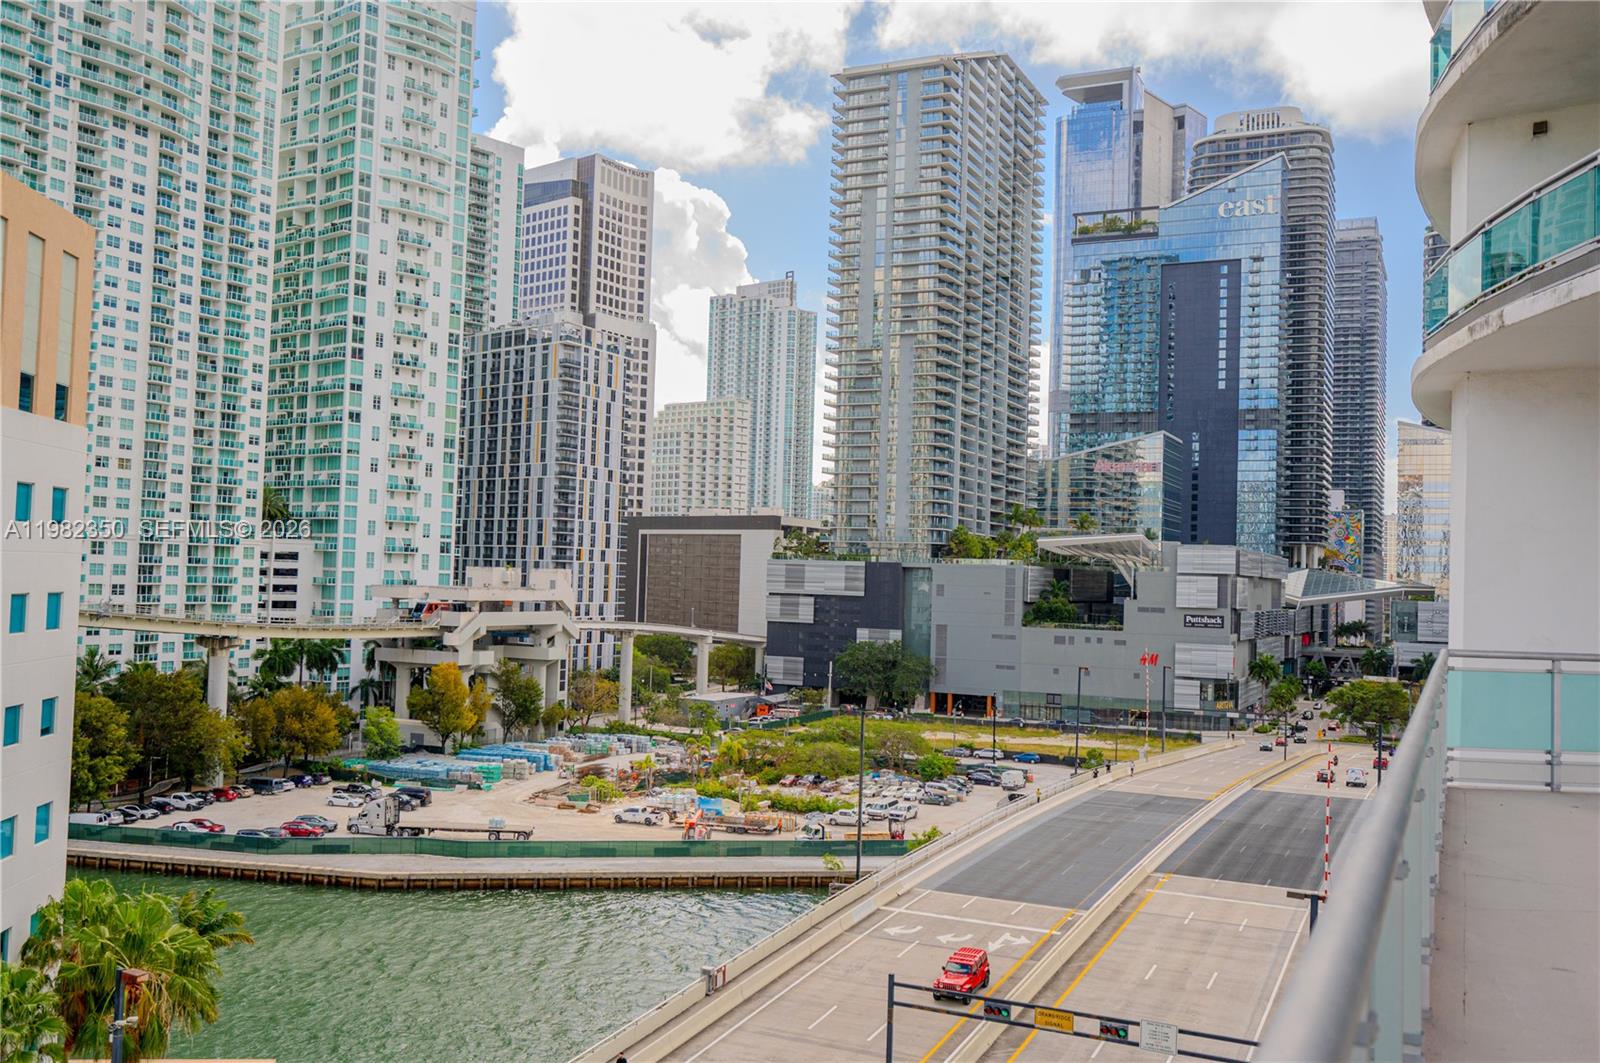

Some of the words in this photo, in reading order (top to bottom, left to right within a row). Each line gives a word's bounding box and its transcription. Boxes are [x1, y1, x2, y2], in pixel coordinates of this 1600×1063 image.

[602, 159, 627, 172] NORTHERN
[628, 169, 648, 178] TRUST
[1218, 194, 1278, 218] east
[1186, 615, 1222, 624] Puttshack
[1140, 653, 1158, 666] HM
[1038, 1010, 1071, 1022] DRAWBRIDGE
[1044, 1020, 1064, 1029] SIGNAL
